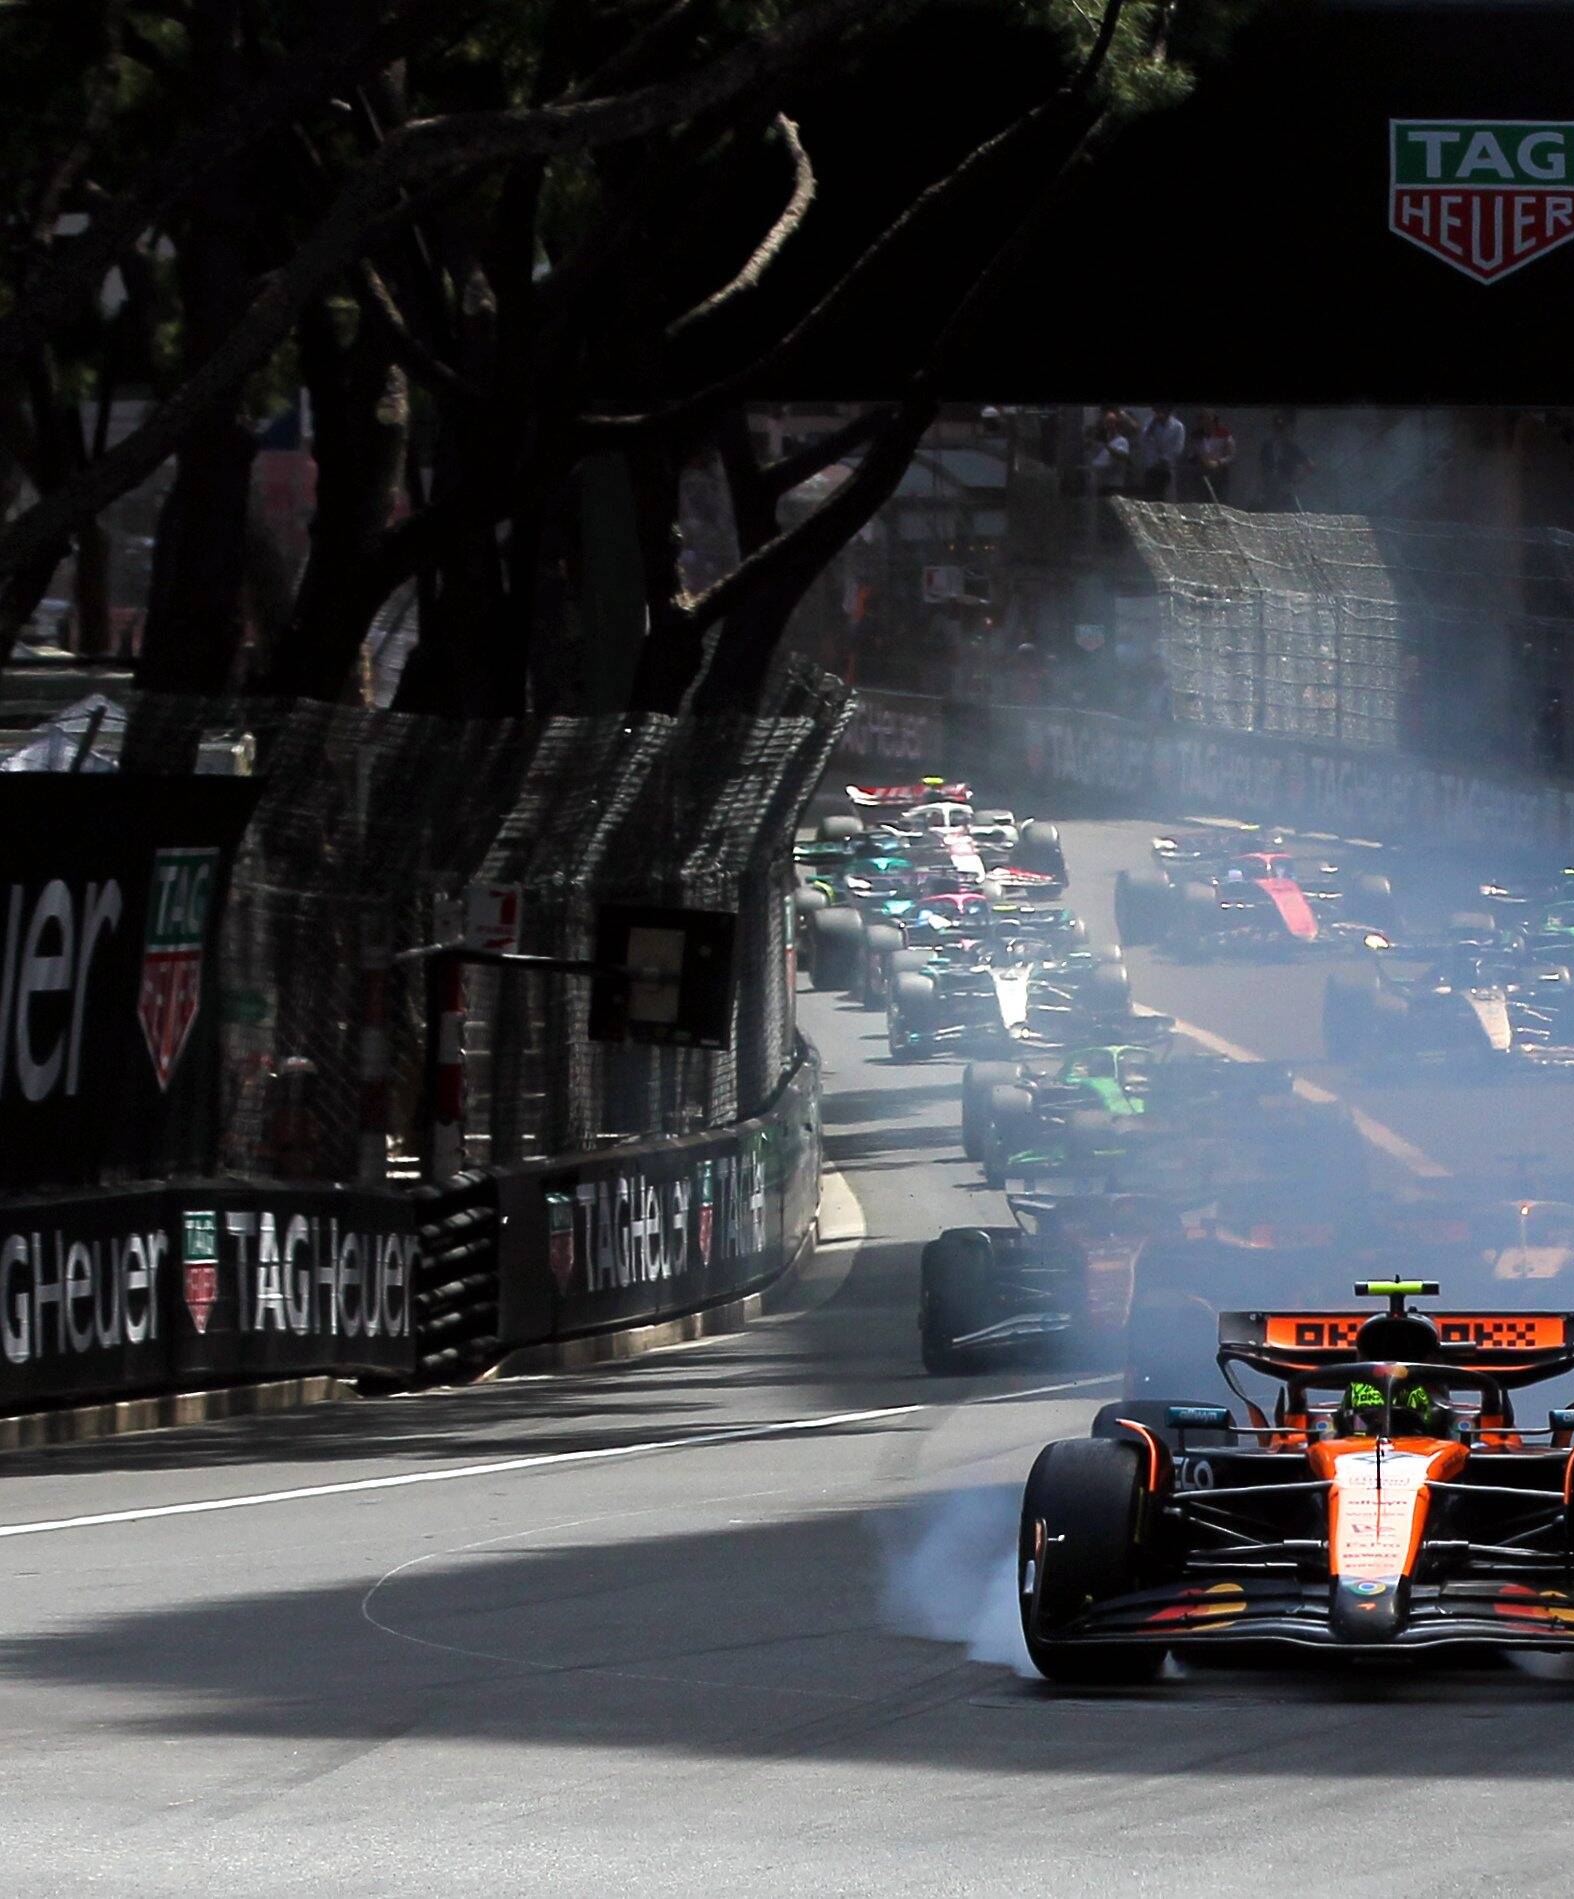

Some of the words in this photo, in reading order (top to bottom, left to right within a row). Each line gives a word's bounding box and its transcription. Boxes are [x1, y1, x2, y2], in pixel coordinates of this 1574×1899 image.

[1407, 131, 1567, 179] TAG
[1402, 194, 1573, 271] HEUER
[1296, 1323, 1357, 1347] OK
